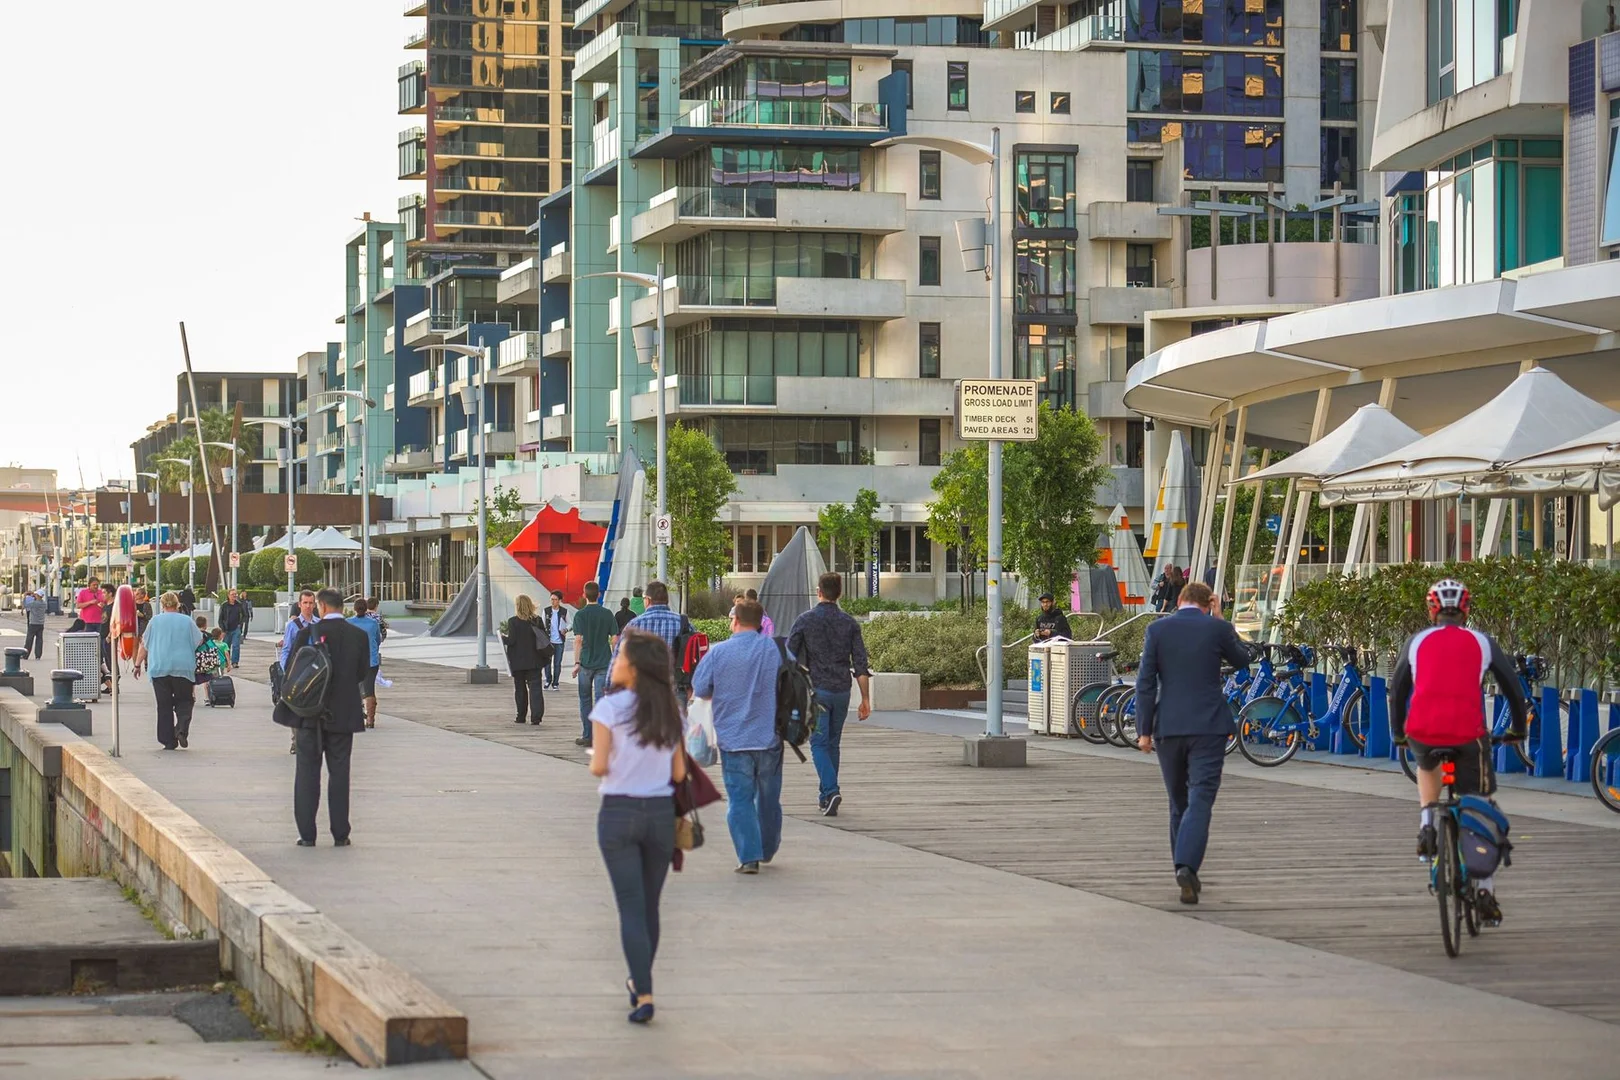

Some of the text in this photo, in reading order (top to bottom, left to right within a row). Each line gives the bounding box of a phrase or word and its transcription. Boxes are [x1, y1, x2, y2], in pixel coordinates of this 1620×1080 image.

[964, 385, 1033, 396] PROMENADE
[964, 398, 1033, 408] GROSS LOAD LIMIT
[964, 415, 993, 423] TIMBER
[995, 415, 1016, 423] DECK
[964, 426, 989, 434] PAVED
